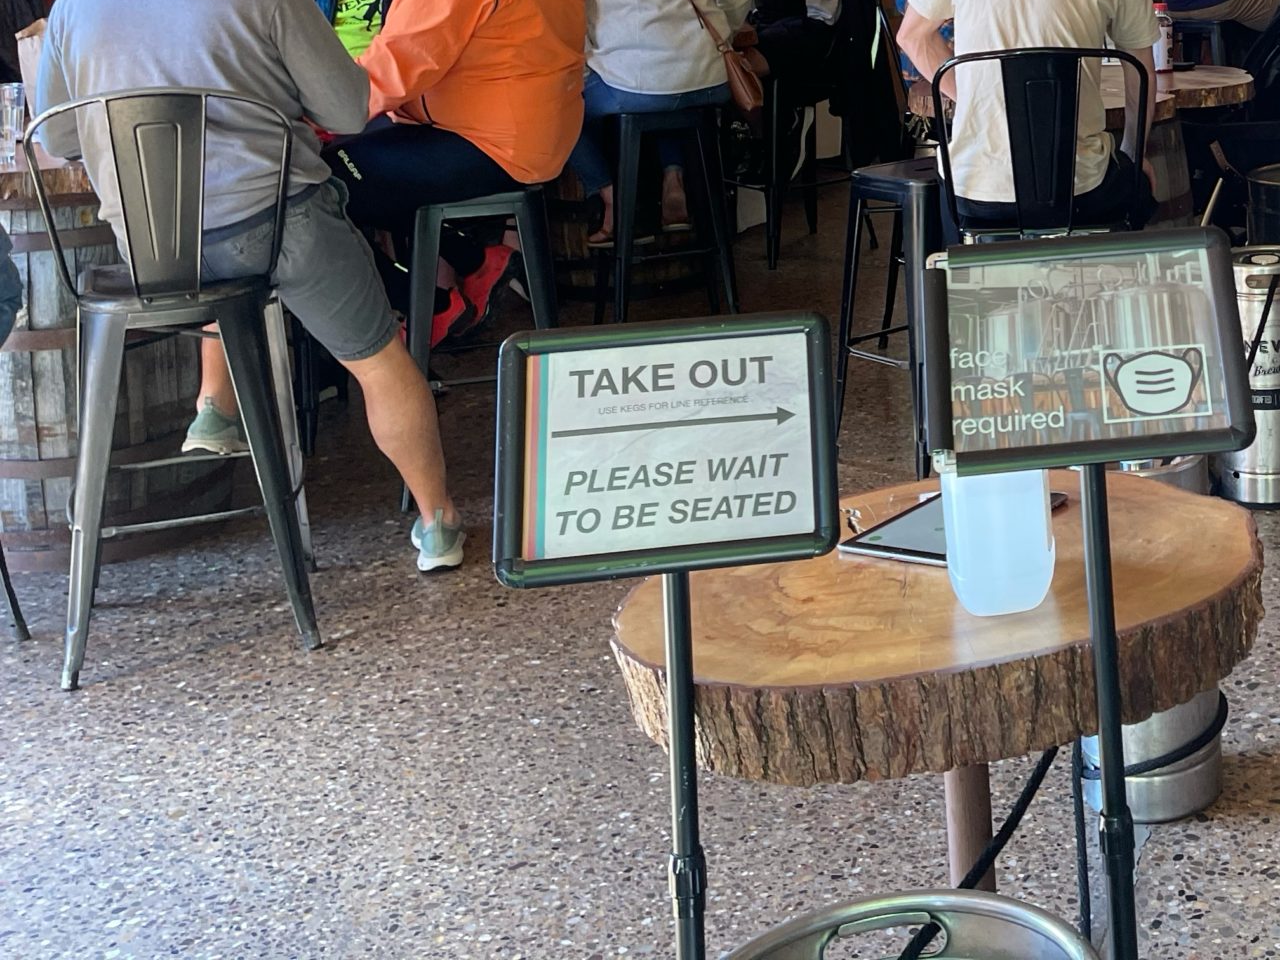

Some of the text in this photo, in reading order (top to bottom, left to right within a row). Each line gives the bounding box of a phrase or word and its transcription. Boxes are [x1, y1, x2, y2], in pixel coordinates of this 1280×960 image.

[950, 347, 1009, 370] face
[569, 355, 774, 399] TAKE OUT
[952, 377, 1025, 403] mask
[598, 395, 750, 416] USE KEGS FOR LINE REFERENCE
[952, 406, 1065, 439] required
[564, 453, 789, 496] PLEASE WAIT
[555, 490, 798, 536] TO BE SEATED
